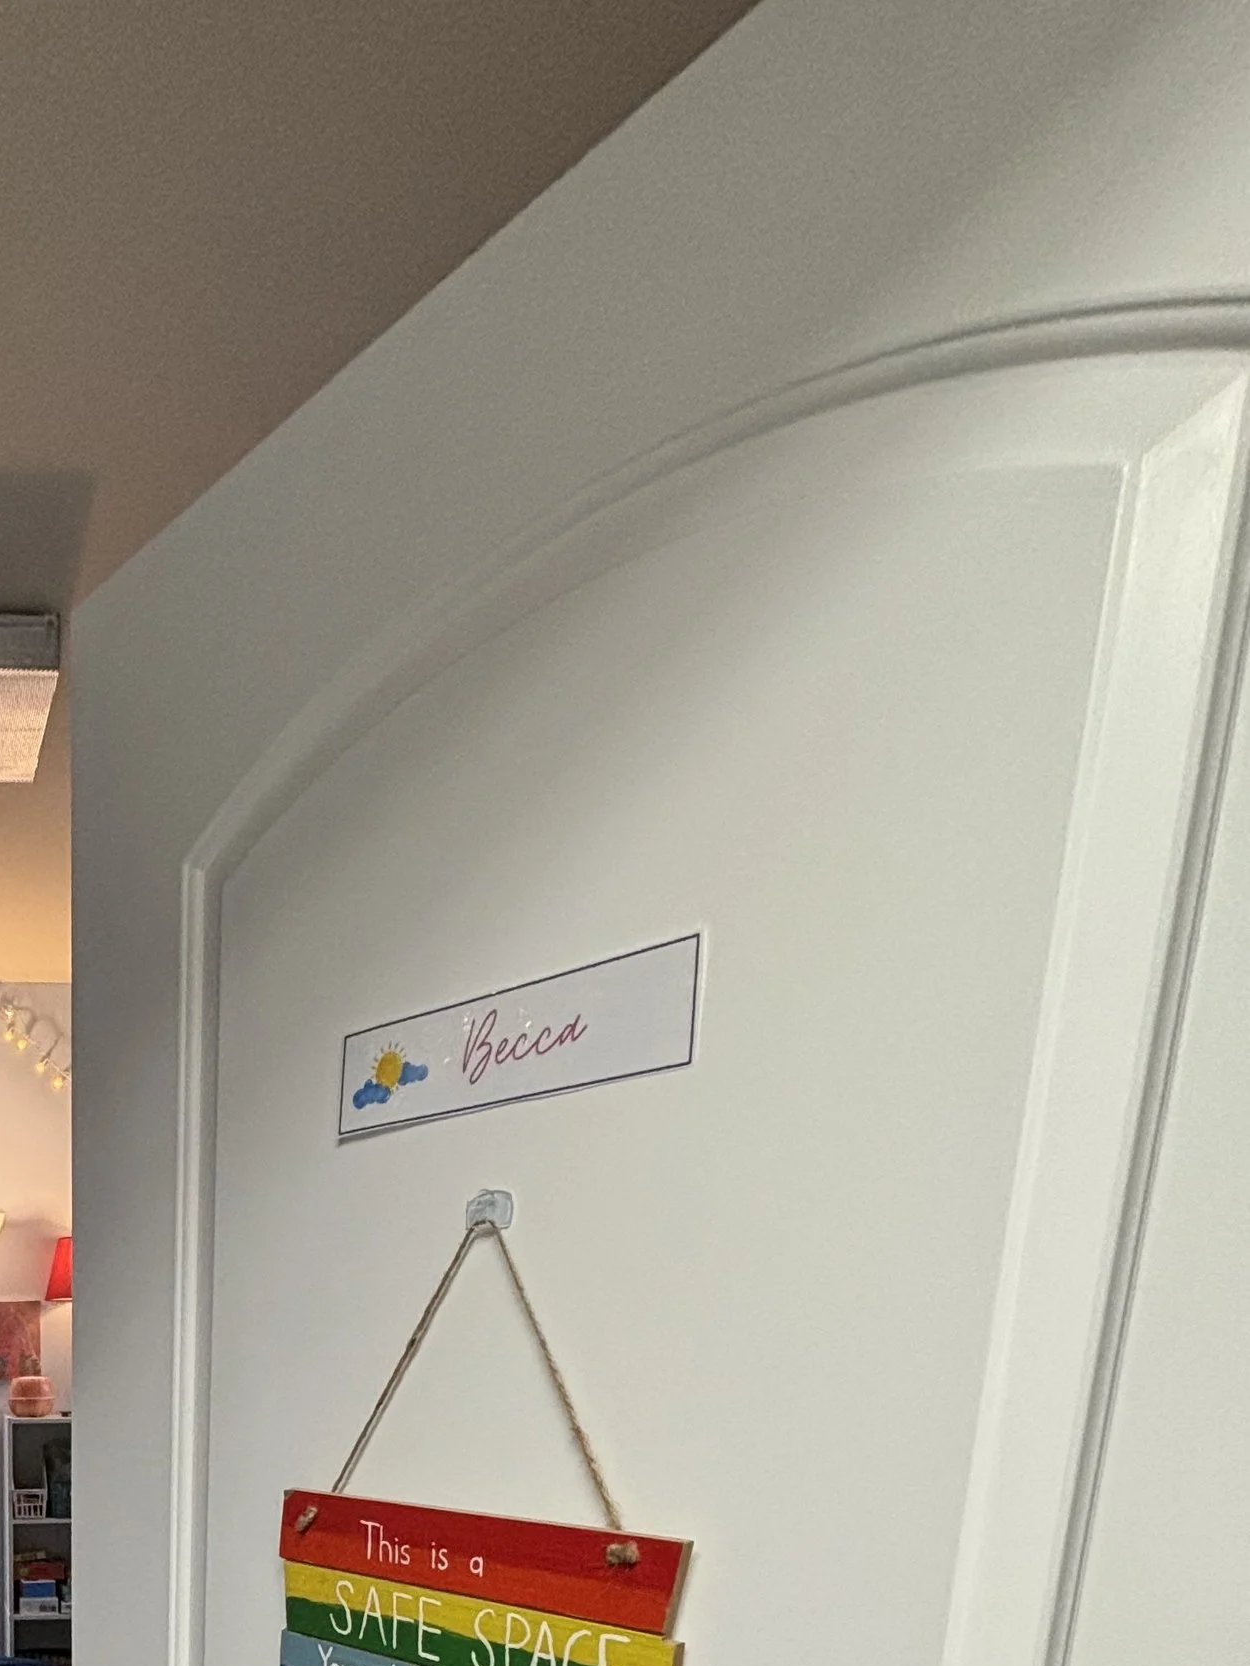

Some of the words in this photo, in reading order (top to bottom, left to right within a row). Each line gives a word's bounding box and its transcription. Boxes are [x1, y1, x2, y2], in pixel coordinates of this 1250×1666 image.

[463, 1008, 588, 1084] Becca
[359, 1519, 411, 1566] This
[430, 1540, 449, 1570] is
[469, 1556, 484, 1577] a
[329, 1580, 441, 1662] SAFE
